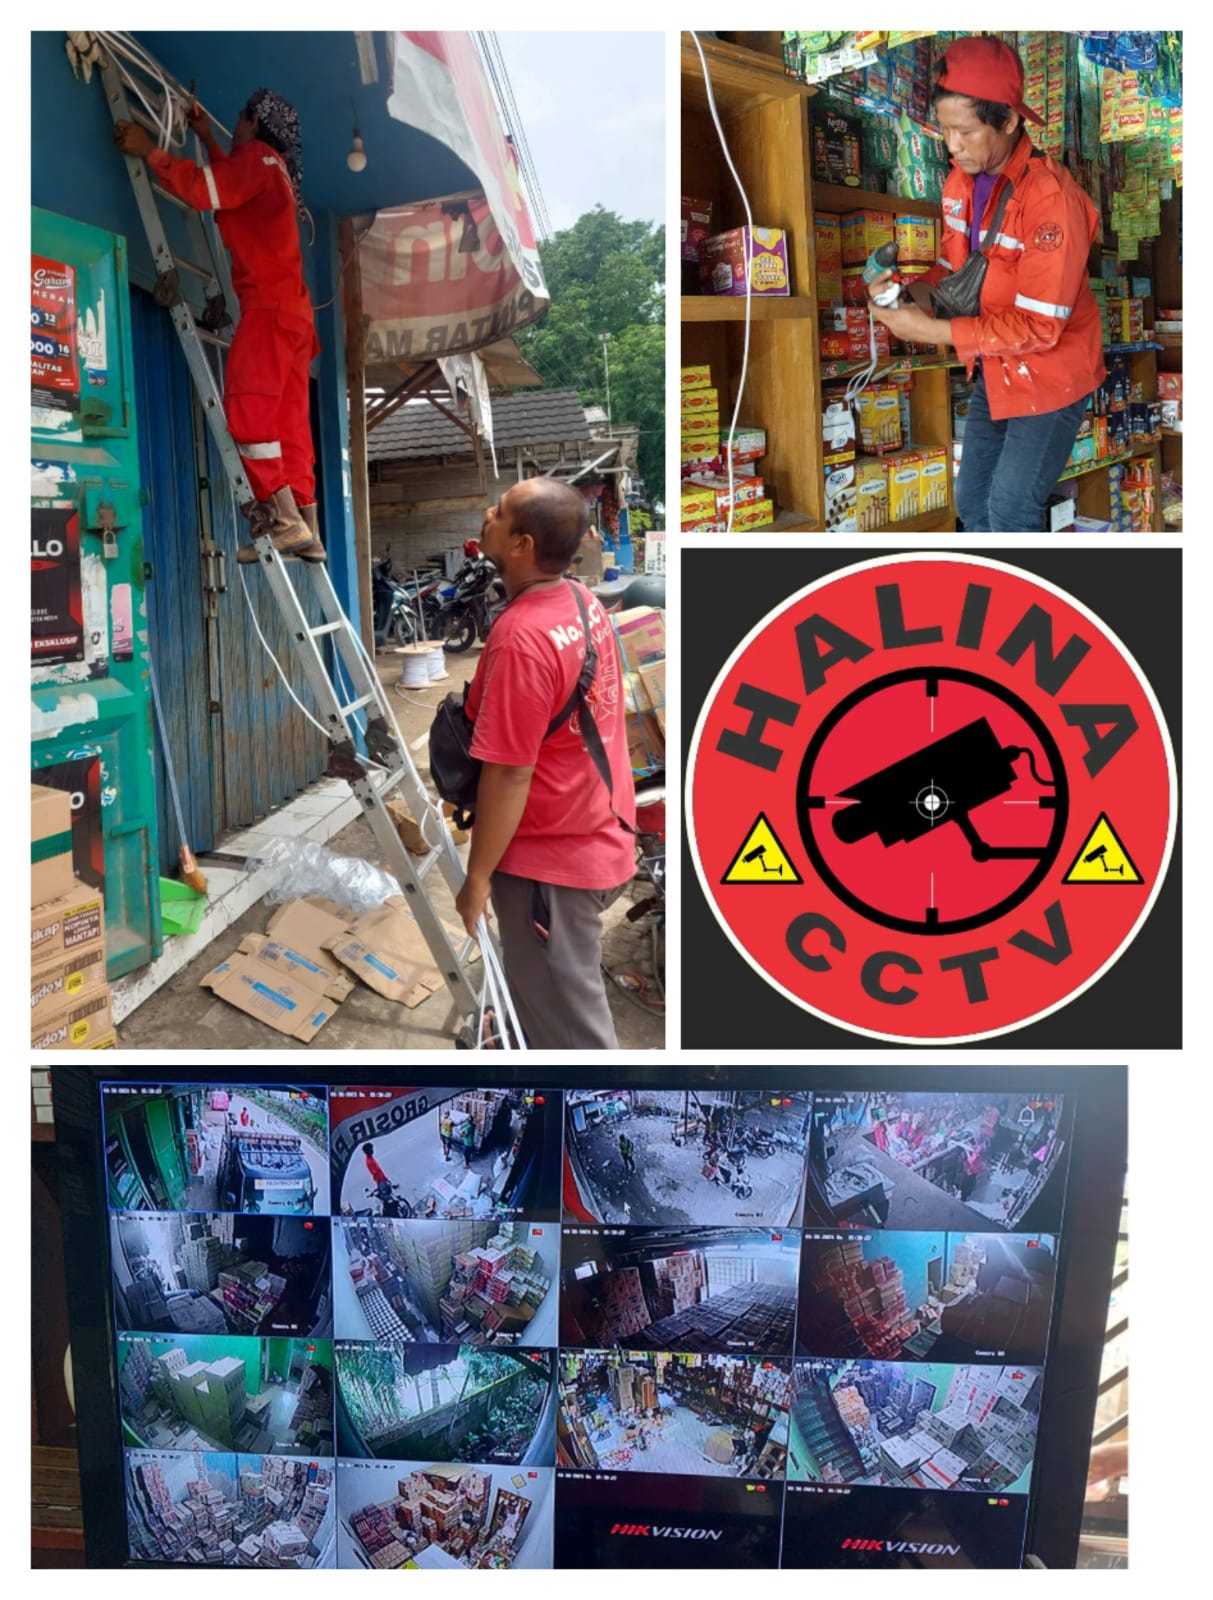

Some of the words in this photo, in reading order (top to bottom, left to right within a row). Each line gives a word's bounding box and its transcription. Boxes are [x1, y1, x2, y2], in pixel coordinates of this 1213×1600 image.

[44, 312, 56, 323] 12
[716, 582, 1140, 780] HALINA
[785, 898, 1073, 1006] CCTV
[609, 1523, 723, 1541] HIKVISION
[841, 1538, 961, 1556] HIKVISION
